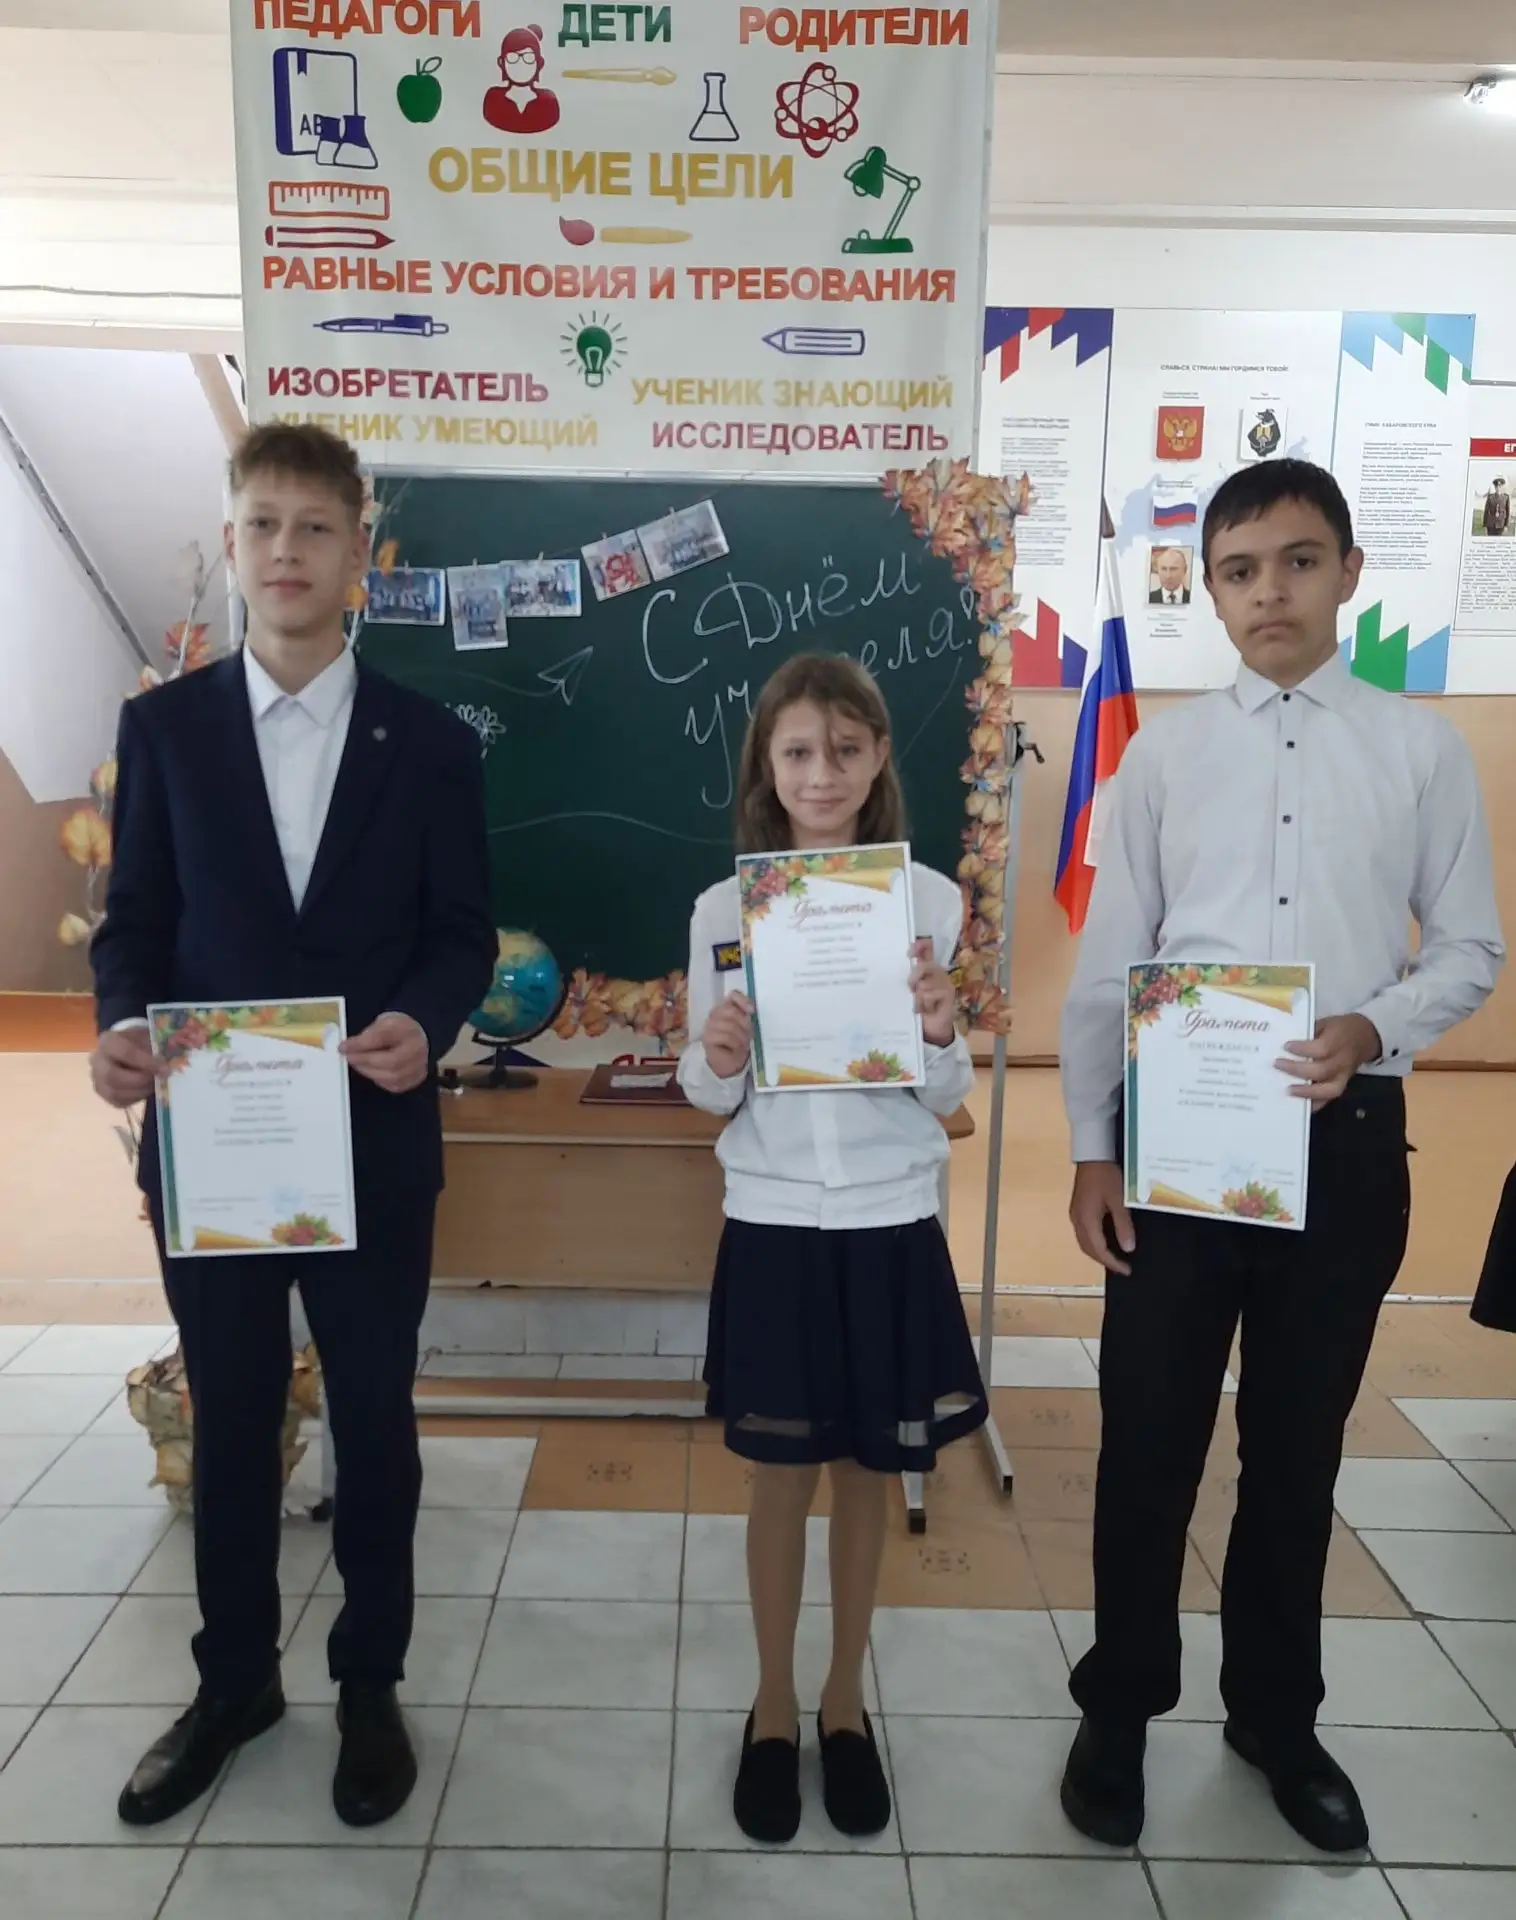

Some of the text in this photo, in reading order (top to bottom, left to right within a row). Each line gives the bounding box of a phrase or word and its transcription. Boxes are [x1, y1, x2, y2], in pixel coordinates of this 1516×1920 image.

[254, 0, 481, 39] ПЕДАГОГИ
[558, 4, 671, 47] ДЕТИ
[740, 7, 968, 52] РОДИТЕЛИ
[429, 147, 793, 205] ОБЩИЕ ЦЕЛИ
[263, 256, 956, 302] РАВНЫЕ УСЛОВИЯ И ТРЕБОВАНИЯ
[268, 367, 549, 402] ИЗОБРЕТАТЕЛЬ
[632, 375, 953, 412] УЧЕНИК ЗНАЮЩИЙ
[411, 413, 598, 450] УМЕЮЩИЙ
[652, 421, 949, 455] ИССЛЕДОВАТЕЛЬ
[643, 552, 921, 684] С Днём
[1176, 1009, 1270, 1038] Грамота
